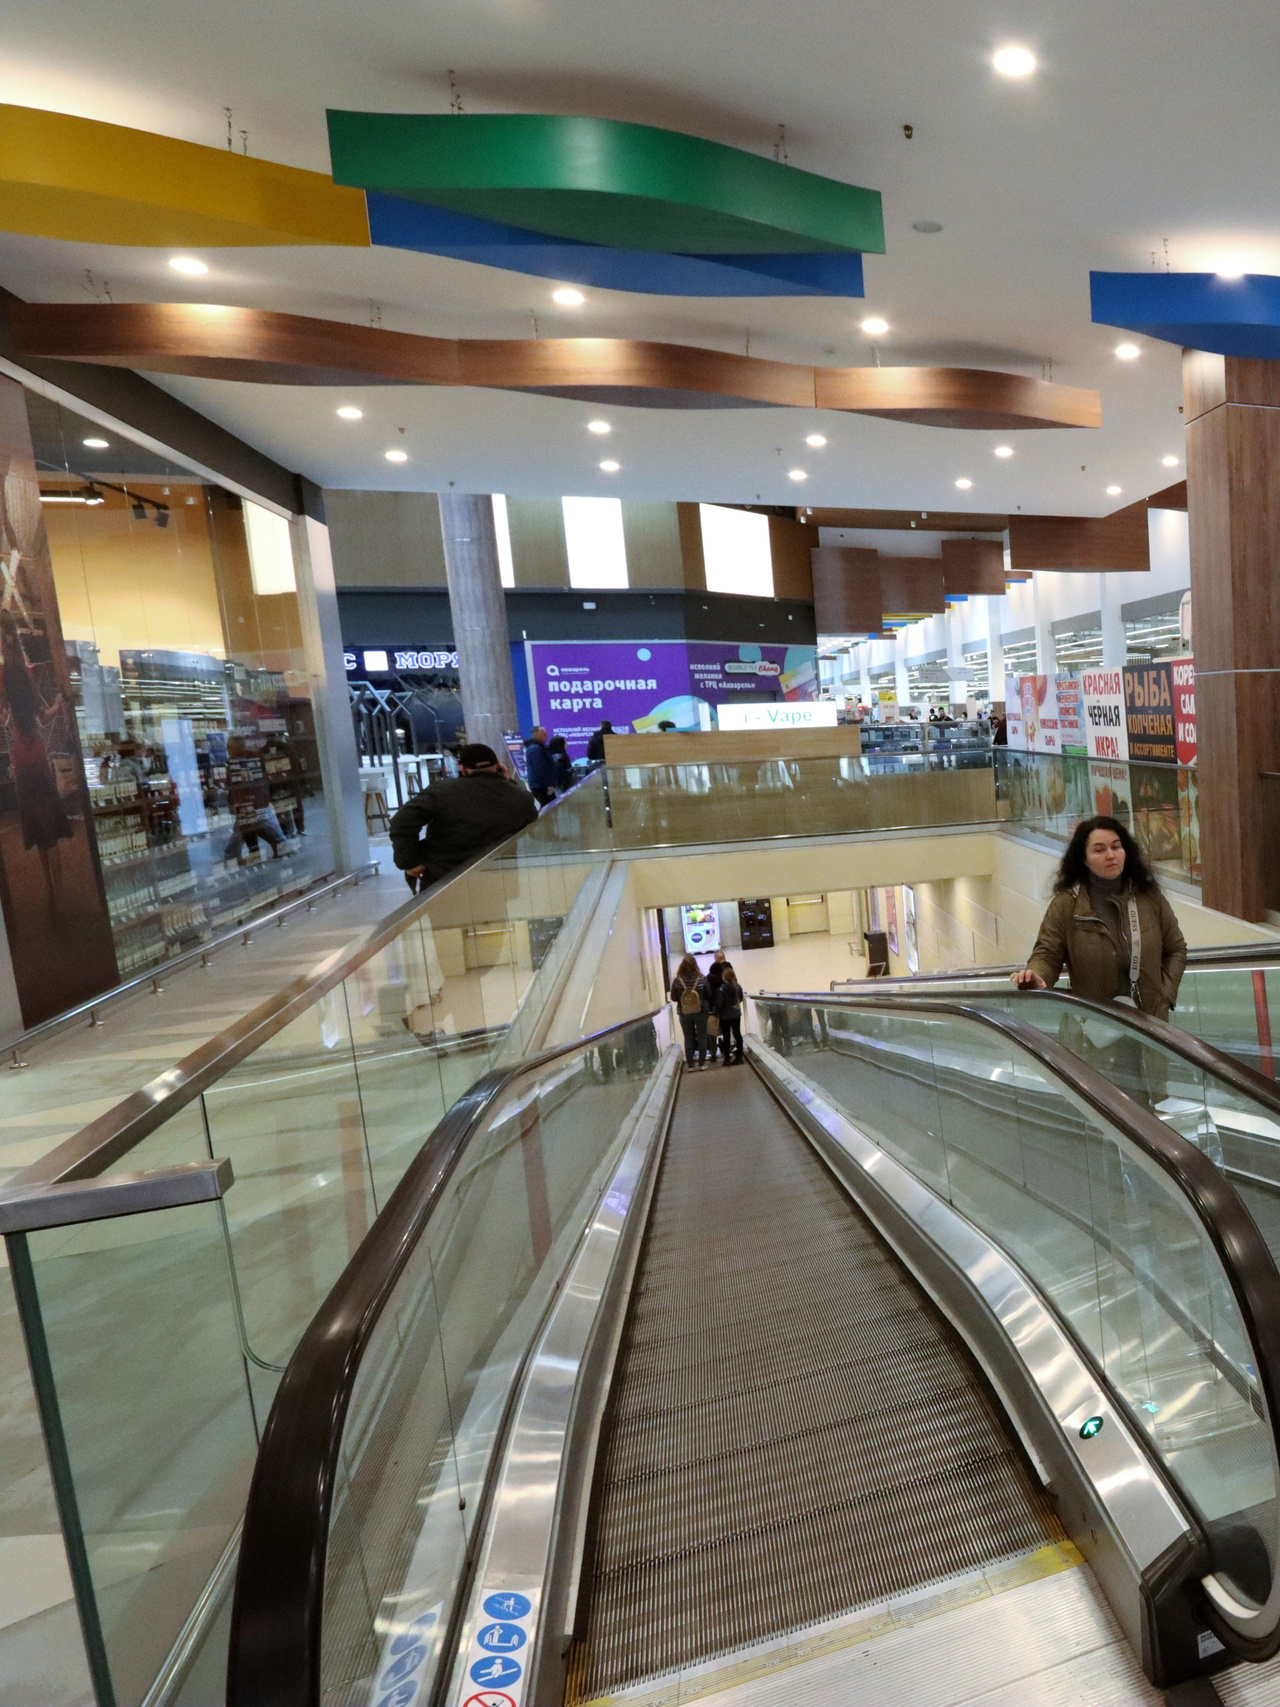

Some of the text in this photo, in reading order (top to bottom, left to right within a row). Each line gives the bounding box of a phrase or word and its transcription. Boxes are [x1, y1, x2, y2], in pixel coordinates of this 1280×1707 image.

[548, 679, 657, 694] подарочная
[1083, 672, 1121, 695] КРАСНАЯ
[1124, 669, 1171, 707] РЫБА
[550, 698, 602, 712] карта
[767, 709, 812, 725] Vape
[1095, 736, 1120, 758] ИКРА!
[1134, 743, 1175, 757] АССОРТИМЕНТЕ
